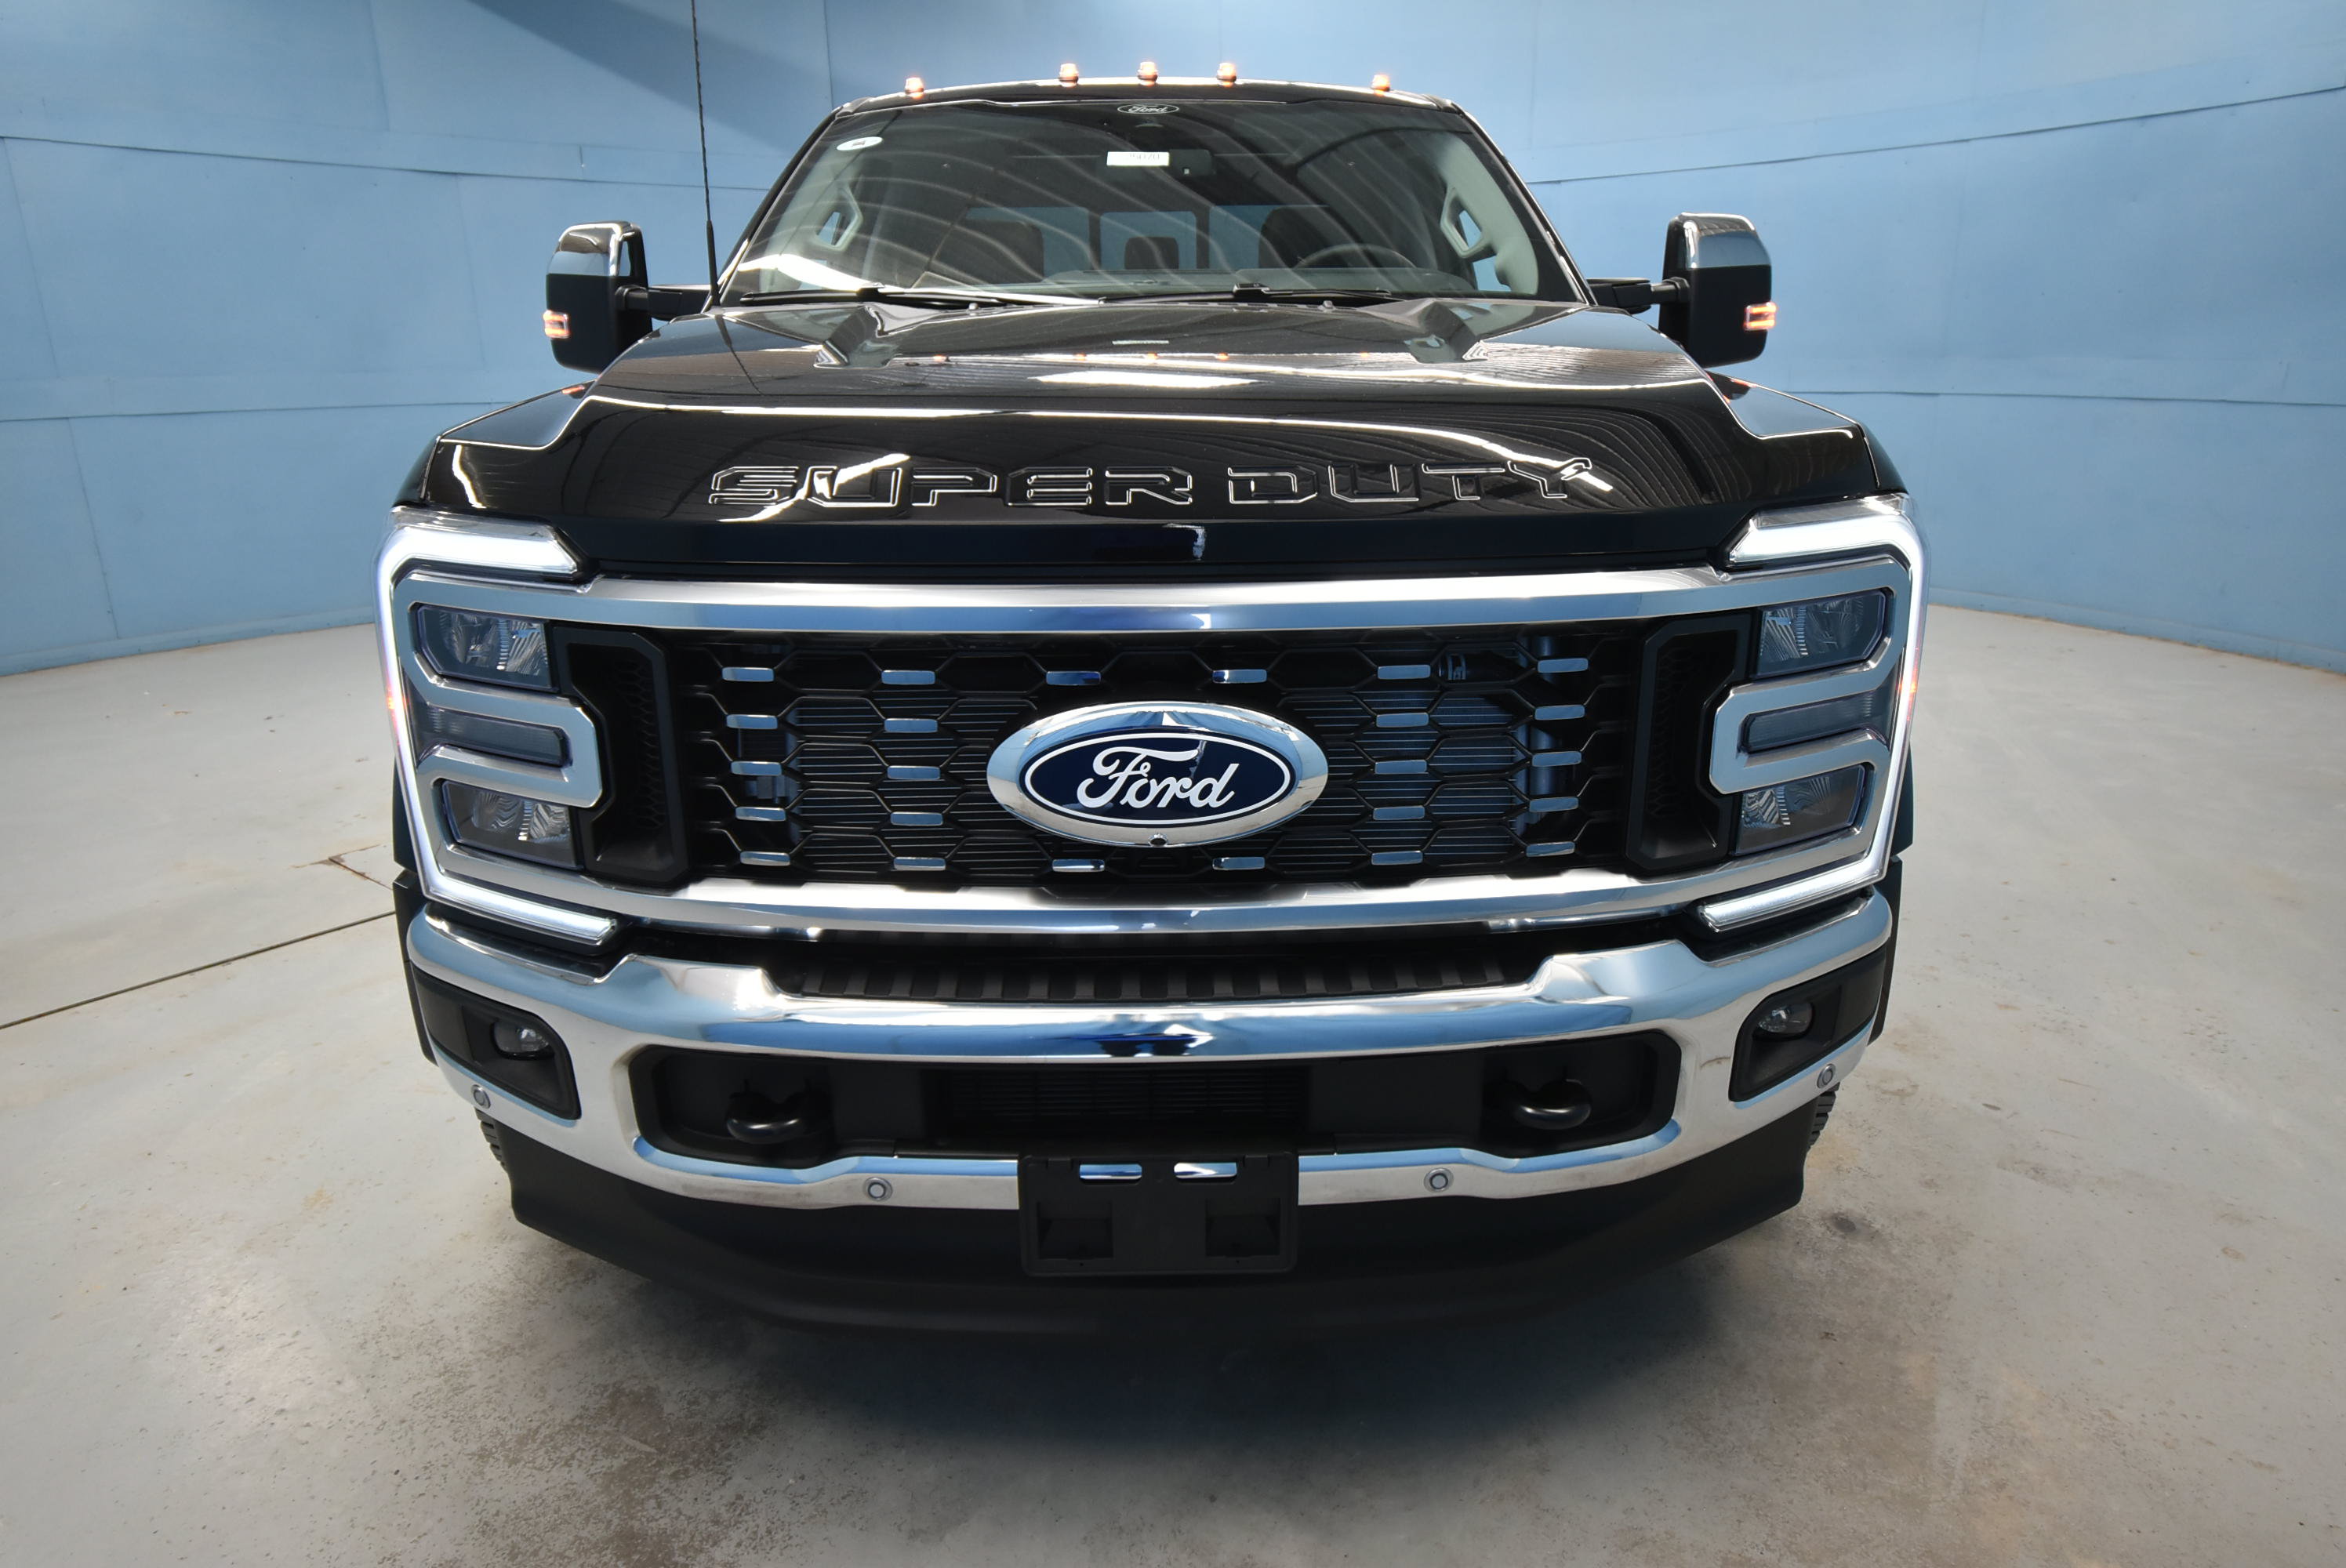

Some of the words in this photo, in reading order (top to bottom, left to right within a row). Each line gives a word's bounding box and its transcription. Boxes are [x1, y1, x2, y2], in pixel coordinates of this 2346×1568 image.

[1128, 103, 1168, 113] Ford
[708, 466, 1193, 508] SUPER
[1227, 457, 1592, 504] DUTY
[1076, 746, 1240, 809] Ford
